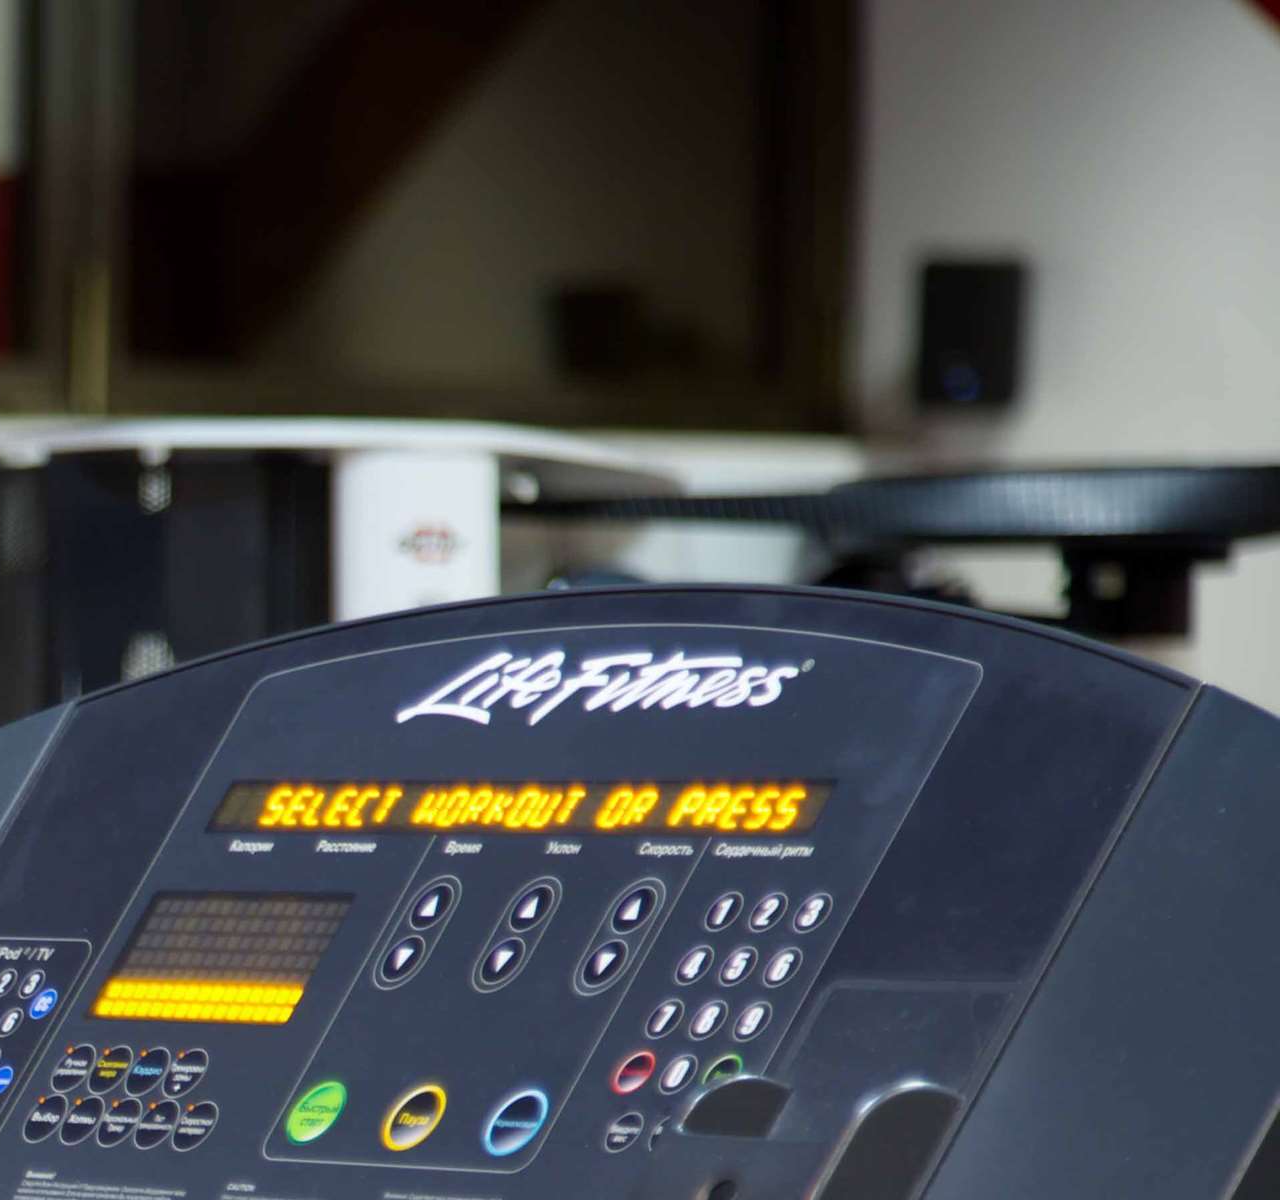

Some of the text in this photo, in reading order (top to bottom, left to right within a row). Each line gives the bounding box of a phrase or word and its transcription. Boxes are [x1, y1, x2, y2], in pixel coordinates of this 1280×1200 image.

[395, 651, 566, 724] Life
[258, 785, 807, 830] SELECT WORKOUT OR PRESS
[638, 842, 695, 857] Скорость
[714, 898, 825, 927] 1 2 3
[682, 951, 794, 982] 4 5 6
[22, 976, 39, 993] 3
[2, 1014, 19, 1032] 6
[653, 1004, 765, 1035] 7 8 9
[666, 1059, 691, 1088] 0
[397, 1112, 431, 1127] Пауза
